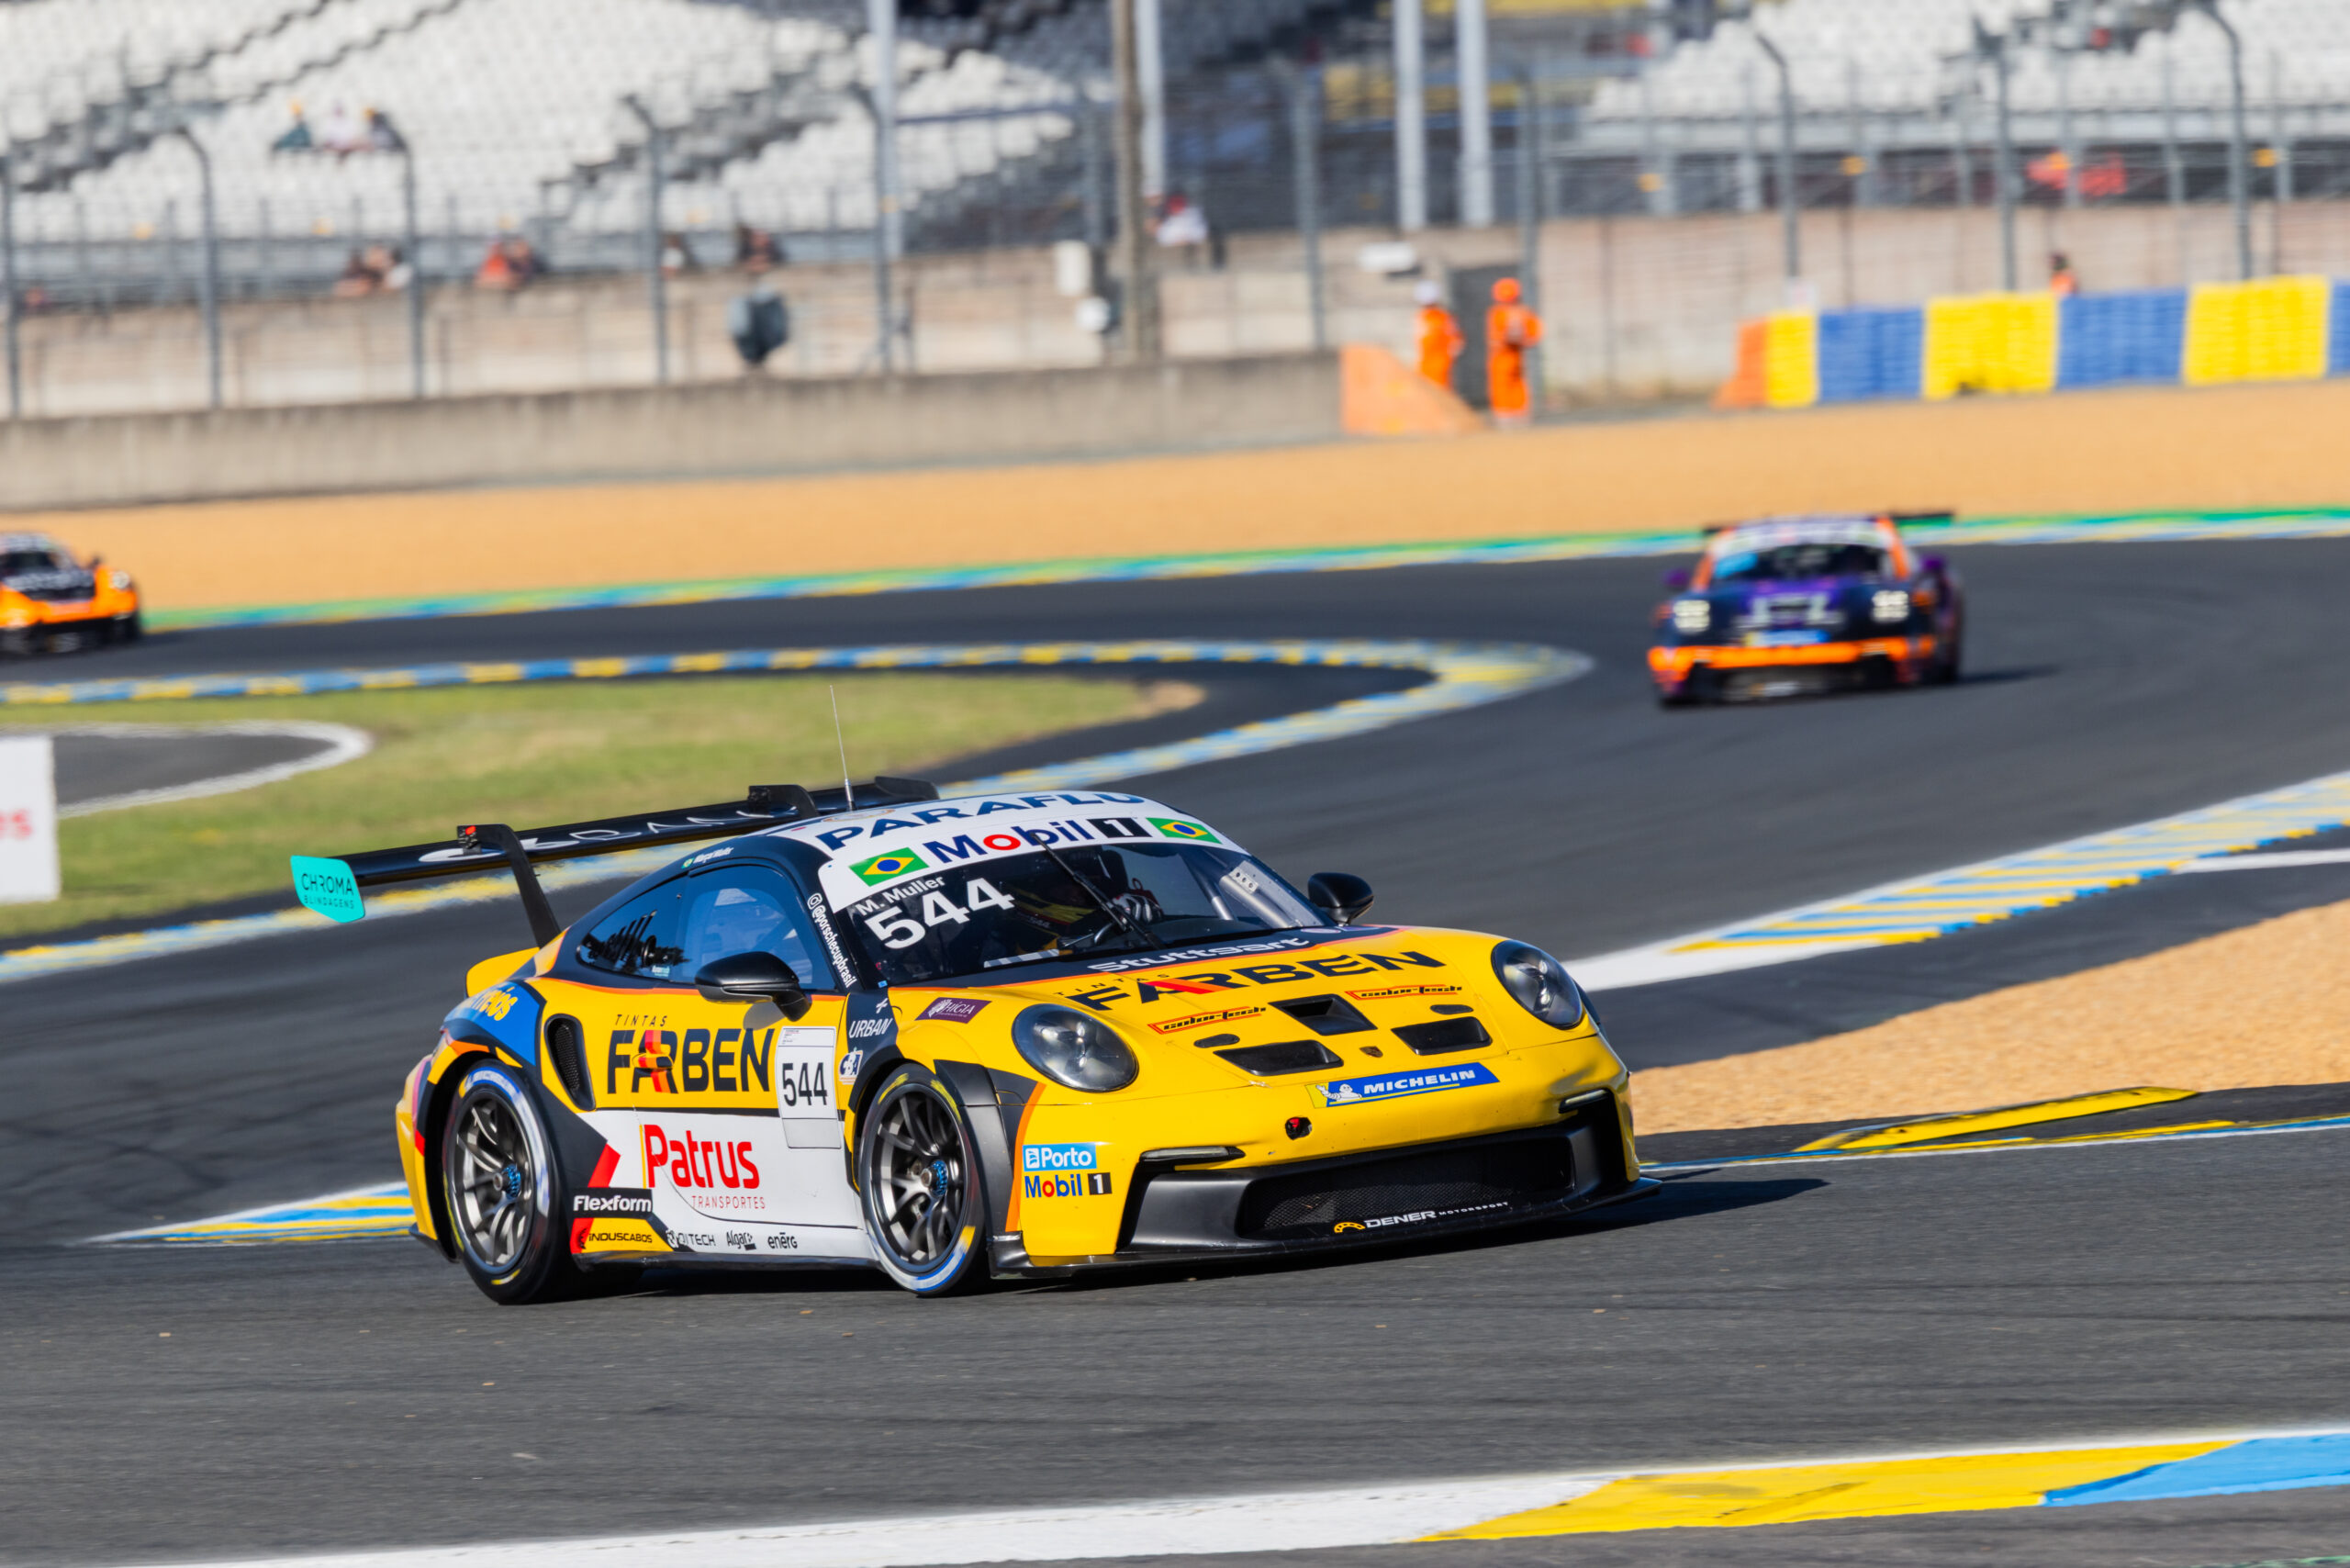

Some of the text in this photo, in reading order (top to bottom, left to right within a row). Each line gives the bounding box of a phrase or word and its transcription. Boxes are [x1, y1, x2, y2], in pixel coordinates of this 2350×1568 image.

[815, 792, 1147, 852] PARAFLU
[922, 819, 1096, 864] Mobil
[301, 873, 354, 896] CHROMA
[856, 898, 886, 917] M.
[864, 877, 1016, 950] 544
[811, 904, 858, 989] @porschecupbrasil
[1087, 935, 1310, 972] Stuttgart
[1053, 973, 1170, 996] TINTAS
[1065, 950, 1448, 1011] FARBEN
[615, 1014, 668, 1027] TINTAS
[848, 1018, 893, 1038] URBAN
[607, 1027, 776, 1094] FARBEN
[781, 1061, 828, 1108] 544
[1364, 1070, 1476, 1094] MICHELIN
[643, 1124, 760, 1189] Patrus
[1041, 1147, 1092, 1168] Porto
[1024, 1173, 1082, 1198] Mobil
[573, 1195, 653, 1212] Flexform
[691, 1195, 766, 1209] TRANSPORTES
[1364, 1201, 1509, 1228] DENER MOTORSPORT
[726, 1230, 747, 1249] Algar
